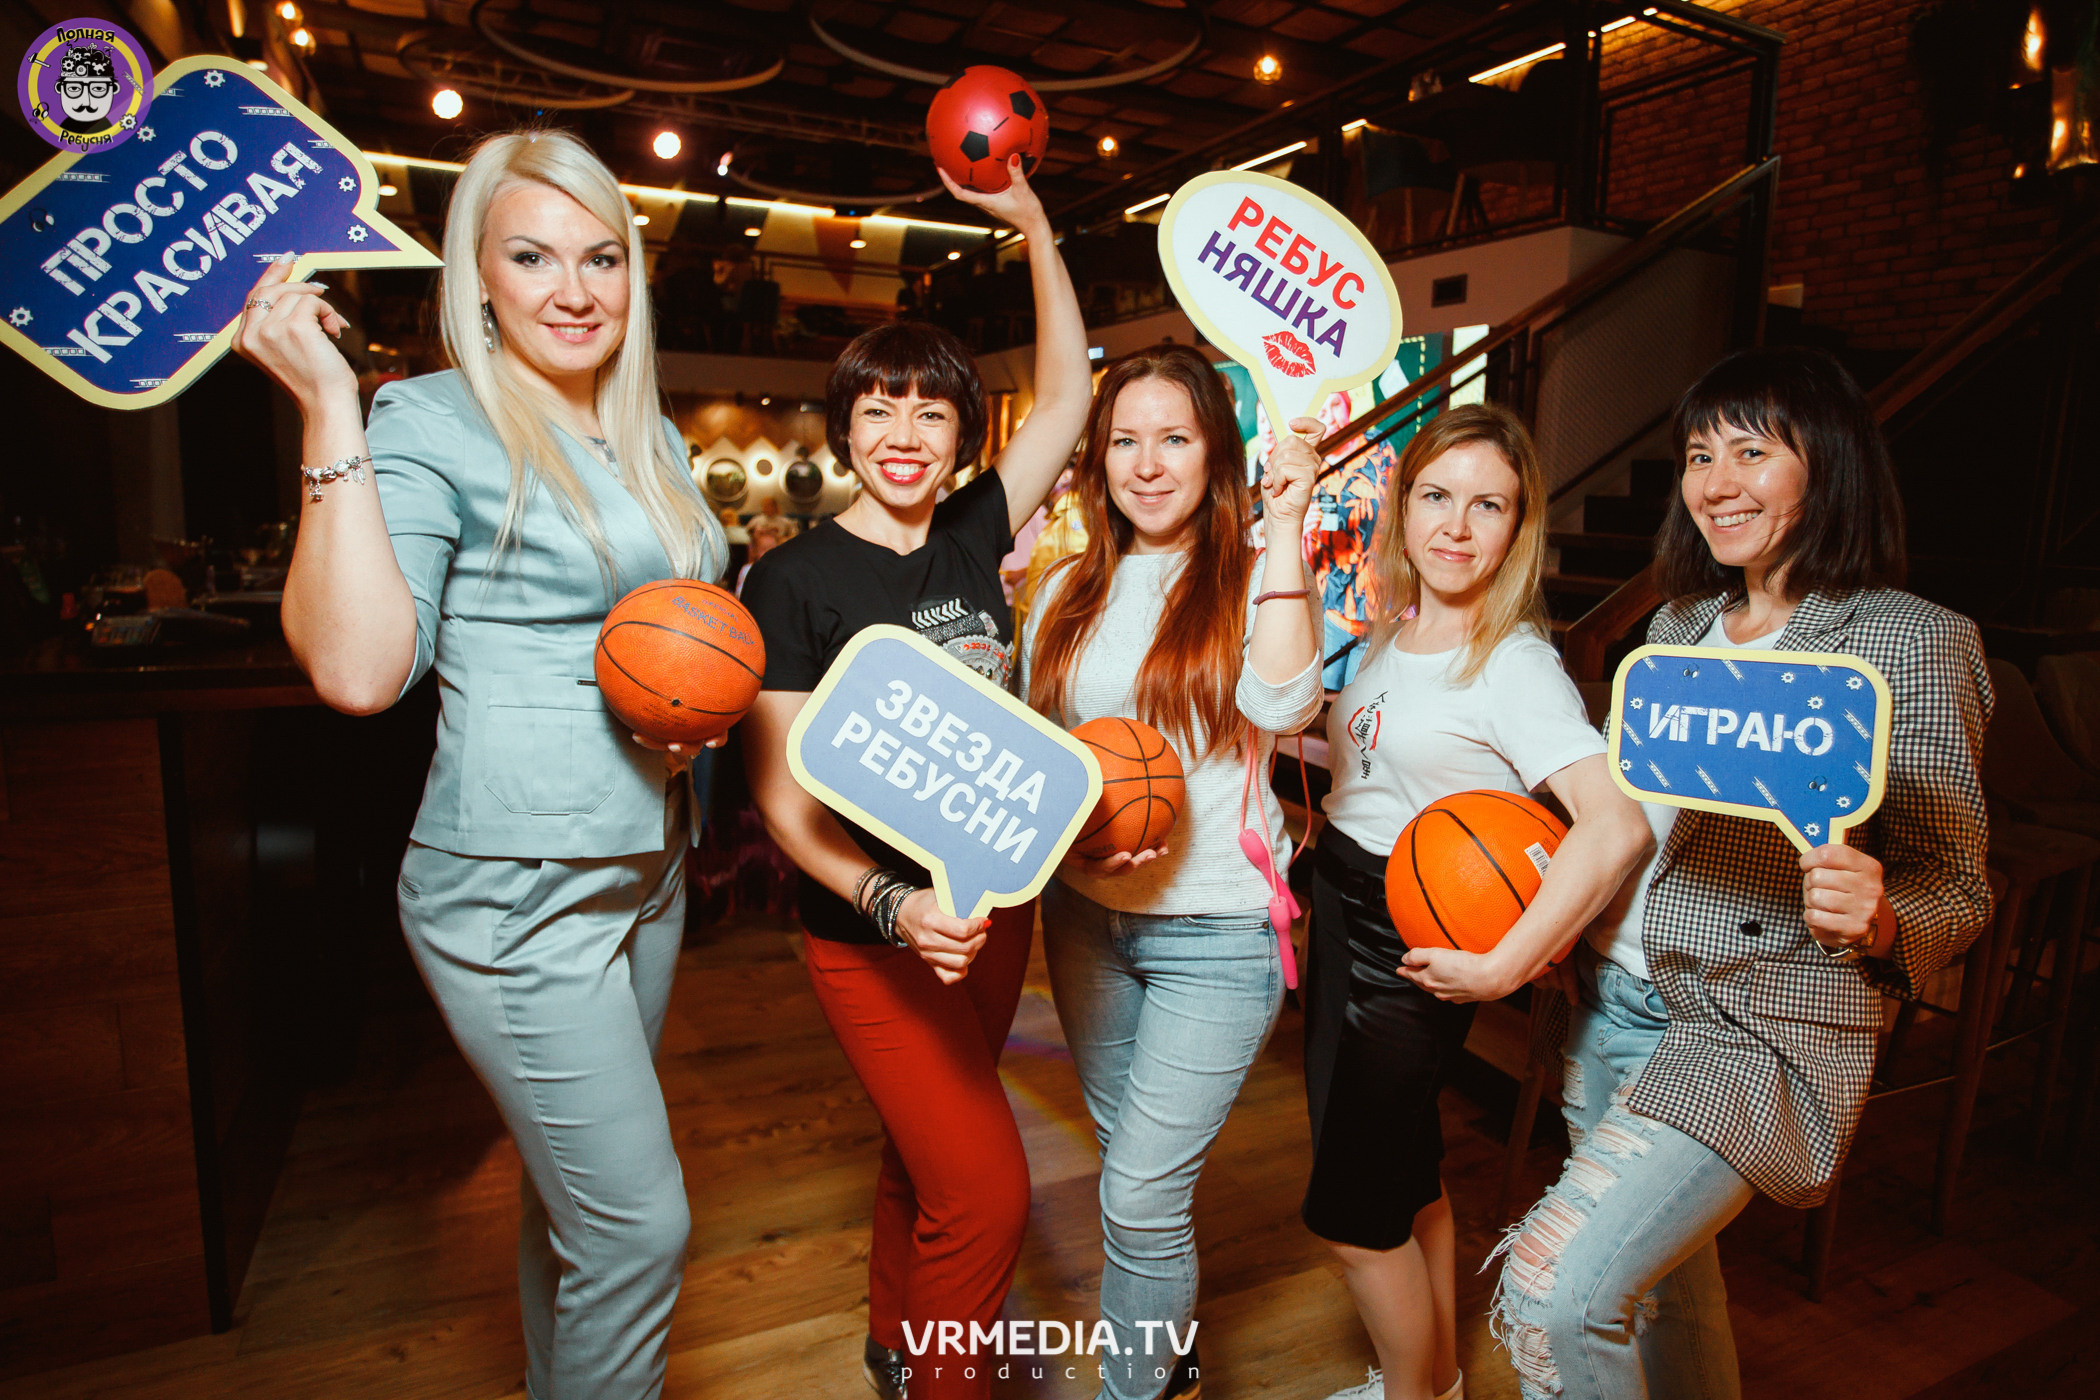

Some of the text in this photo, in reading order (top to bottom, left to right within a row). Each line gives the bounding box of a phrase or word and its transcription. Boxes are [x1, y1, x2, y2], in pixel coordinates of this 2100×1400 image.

[40, 131, 238, 297] ПРОСТО
[67, 142, 324, 364] КРАСИВАЯ
[1227, 196, 1365, 310] РЕБУС
[1197, 230, 1347, 358] НЯШКА
[831, 711, 1039, 864] РЕБУСНИ
[875, 680, 1046, 815] ЗВЕЗДА
[1649, 703, 1834, 757] ИГРАЮ
